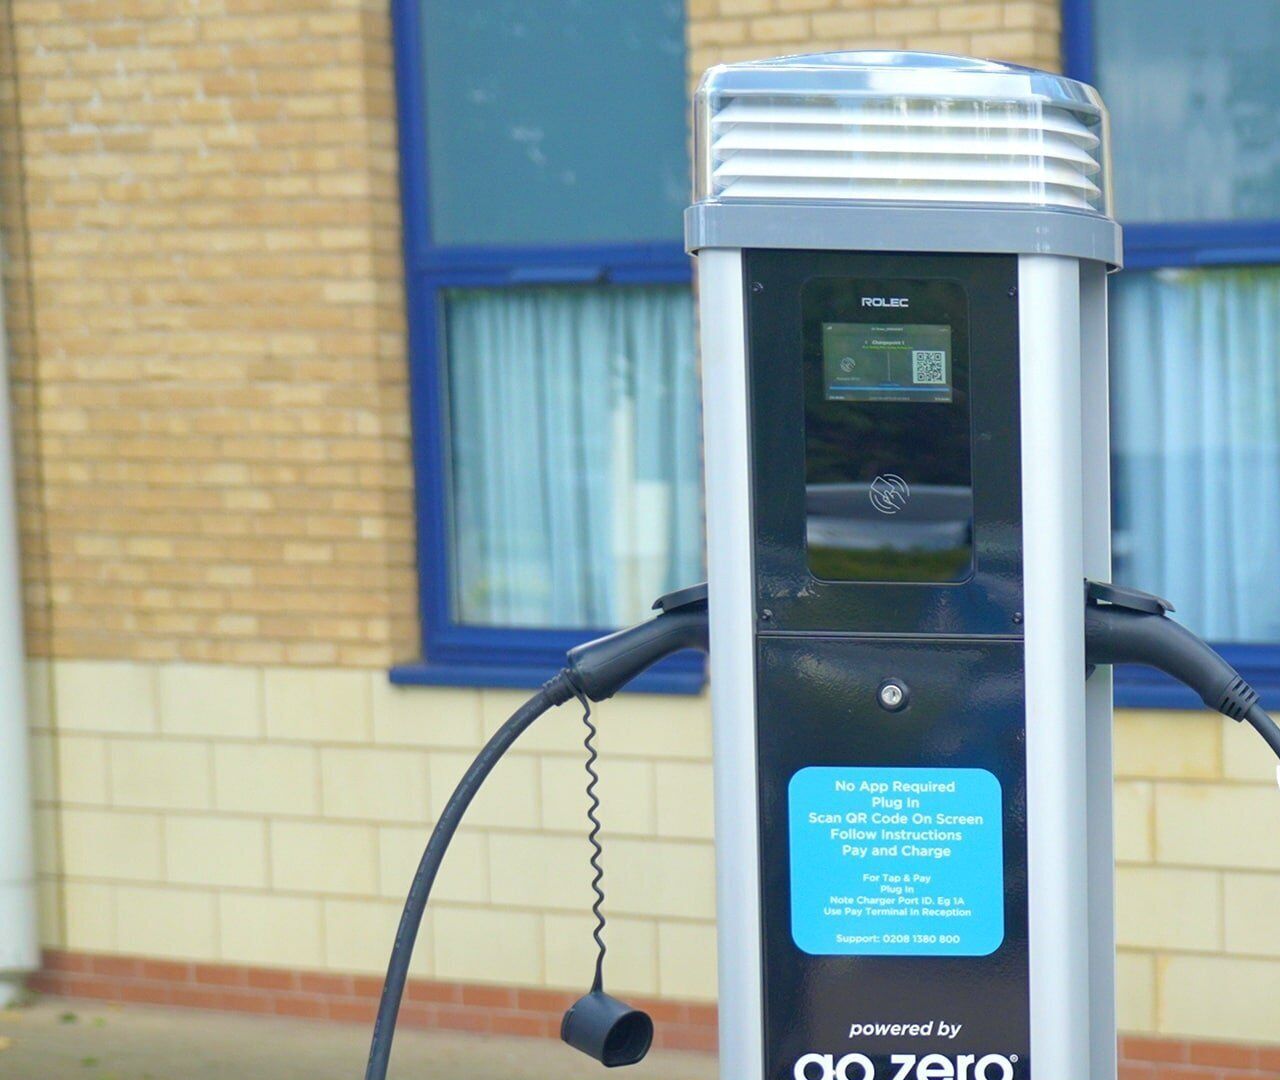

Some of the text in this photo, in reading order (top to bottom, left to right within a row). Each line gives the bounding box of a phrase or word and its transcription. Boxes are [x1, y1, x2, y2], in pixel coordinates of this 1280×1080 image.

[861, 297, 909, 308] ROLEC
[835, 781, 956, 794] No App Required
[871, 797, 920, 810] Plug In
[809, 812, 984, 825] Scan QR Code On Screen
[830, 829, 963, 841] Follow Instructions
[842, 845, 952, 858] Pay and Charge
[862, 873, 931, 886] For Tap & Pay
[880, 884, 915, 896] Plug In
[829, 895, 855, 905] Note
[856, 896, 895, 907] Charger
[898, 896, 919, 905] Port
[937, 896, 951, 907] Eg
[824, 907, 972, 919] Use Pay Terminal In Reception
[836, 934, 880, 945] Support:
[883, 934, 910, 944] 0208
[939, 934, 961, 944] 800
[849, 1021, 962, 1039] powered by
